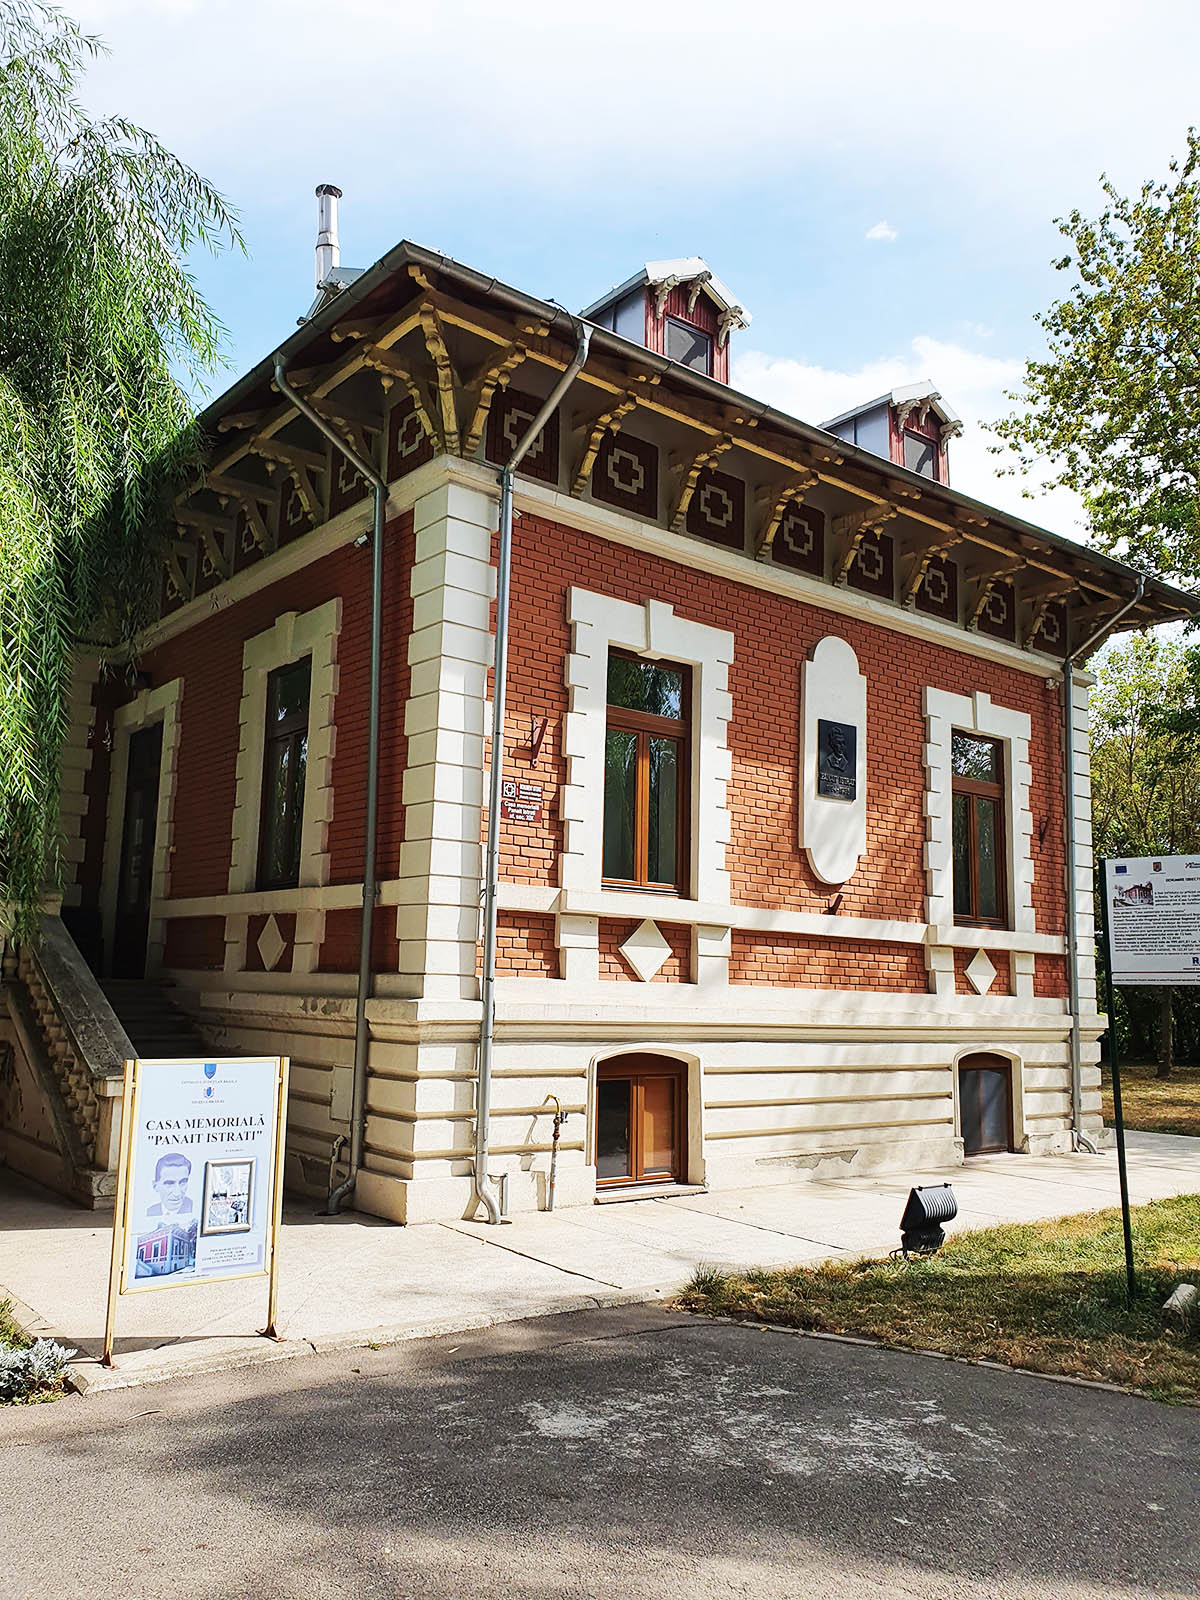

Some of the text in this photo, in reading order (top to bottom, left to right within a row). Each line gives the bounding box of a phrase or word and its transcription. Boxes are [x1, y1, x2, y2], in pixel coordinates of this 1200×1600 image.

[146, 1114, 265, 1131] CASA MEMORIALĂ
[148, 1130, 263, 1145] "PANAIT ISTRATI"
